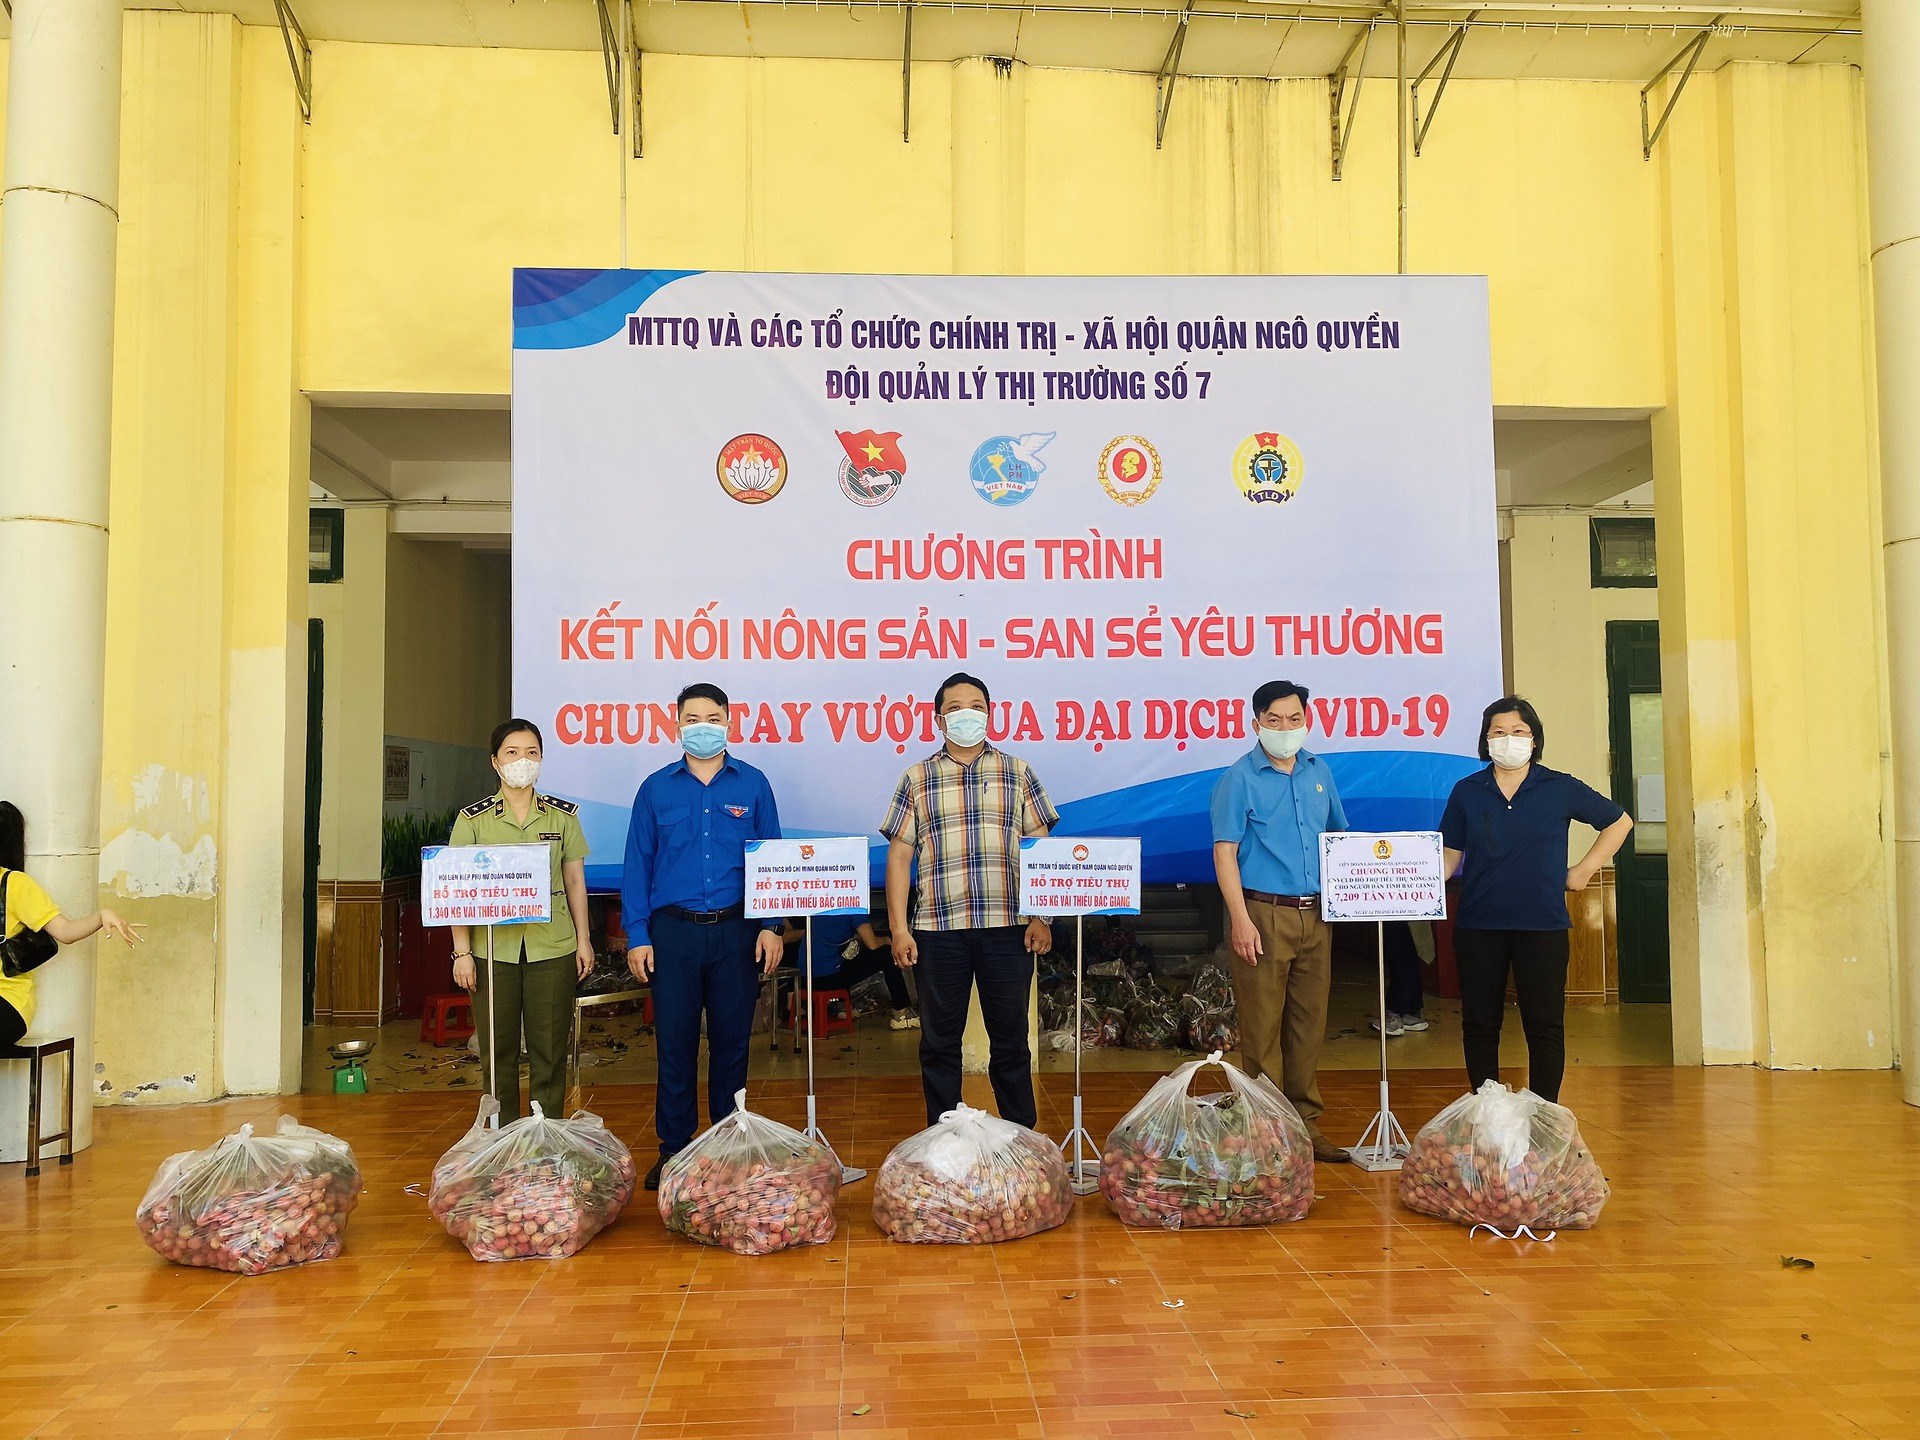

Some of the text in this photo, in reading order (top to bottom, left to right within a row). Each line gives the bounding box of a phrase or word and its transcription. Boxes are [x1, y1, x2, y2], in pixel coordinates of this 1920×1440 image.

[628, 317, 699, 349] MTTQ
[707, 312, 743, 346] VÀ
[751, 311, 803, 347] CÁC
[811, 306, 844, 348] TỔ
[852, 312, 920, 349] CHỨC
[930, 312, 1009, 349] CHÍNH
[1016, 321, 1056, 356] TRỊ
[1082, 316, 1119, 349] XÃ
[1125, 314, 1168, 356] HỘI
[1178, 314, 1247, 356] QUẬN
[1256, 314, 1308, 349] NGÔ
[1316, 311, 1400, 352] QUYỀN
[826, 362, 1210, 406] ĐỘI QUẢN LÝ THỊ TRƯỜNG SỐ 7
[1006, 483, 1023, 491] NAM
[847, 529, 1163, 581] CHƯƠNG TRÌNH
[561, 602, 644, 660] KẾT
[655, 602, 728, 660] NỐI
[742, 608, 867, 660] NÔNG
[878, 607, 967, 660] SẢN
[1005, 618, 1095, 659] SAN
[1106, 606, 1162, 659] SẺ
[1171, 606, 1255, 658] YÊU
[1265, 608, 1444, 657] THƯƠNG
[556, 695, 1450, 755] CHUN TAY VƯỢT UA ĐẠI DỊCH VID-19
[755, 877, 857, 891] HỖ TRỢ TIÊU THỤ
[1030, 874, 1130, 890] HỖ TRỢ TIÊU THỤ
[433, 885, 538, 900] HỖ TRỢ TIÊU THỤ
[753, 898, 766, 910] 210
[769, 898, 779, 909] KG
[782, 894, 794, 909] VẢI
[820, 892, 835, 908] BẮC
[837, 896, 860, 907] GIANG
[1029, 895, 1048, 906] 1.155
[1049, 895, 1059, 906] KG
[1061, 891, 1071, 907] VẢI
[1094, 892, 1107, 907] BẮC
[1110, 896, 1130, 907] GIANG
[428, 906, 449, 919] 1.340
[451, 906, 462, 918] KG
[463, 902, 476, 918] VẢI
[502, 901, 516, 917] BẮC
[519, 905, 543, 916] GIANG
